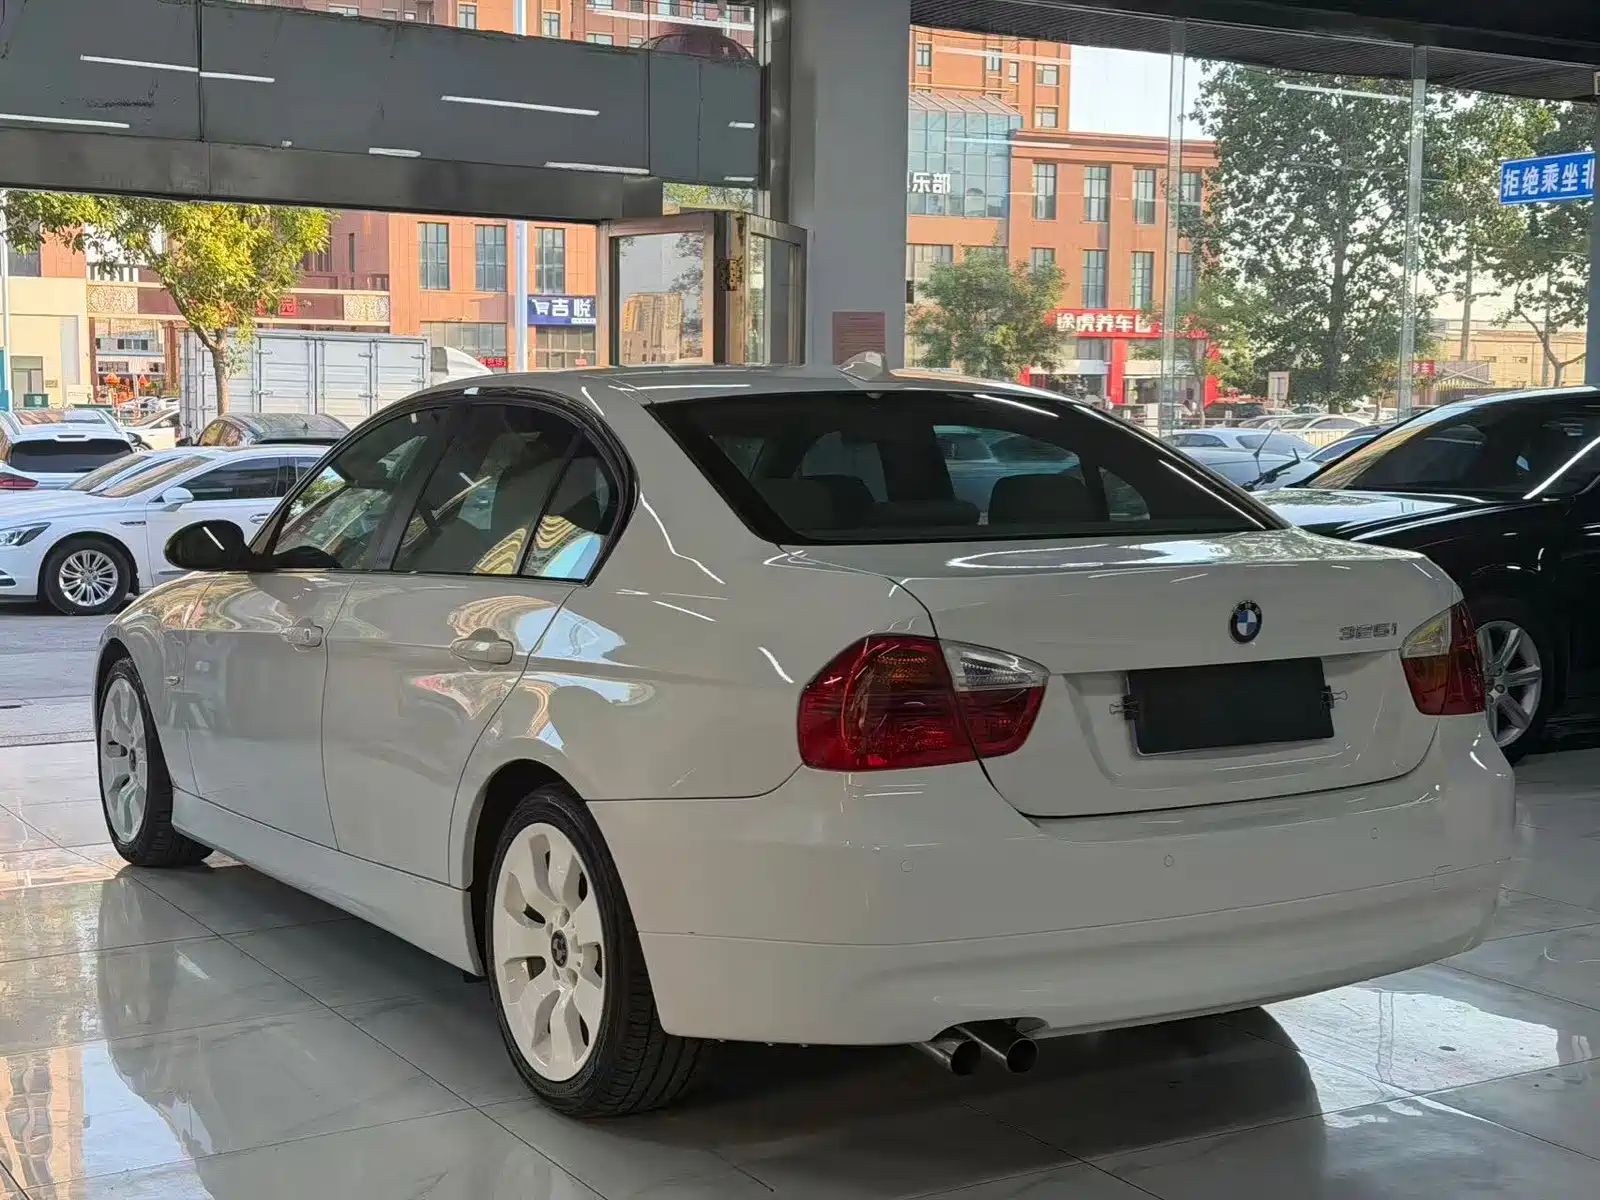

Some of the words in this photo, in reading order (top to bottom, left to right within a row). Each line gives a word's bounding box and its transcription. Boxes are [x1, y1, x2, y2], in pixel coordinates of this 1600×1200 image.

[907, 172, 951, 194] 乐部
[1503, 158, 1595, 197] 拒绝乘坐非
[551, 298, 593, 317] 吉悦
